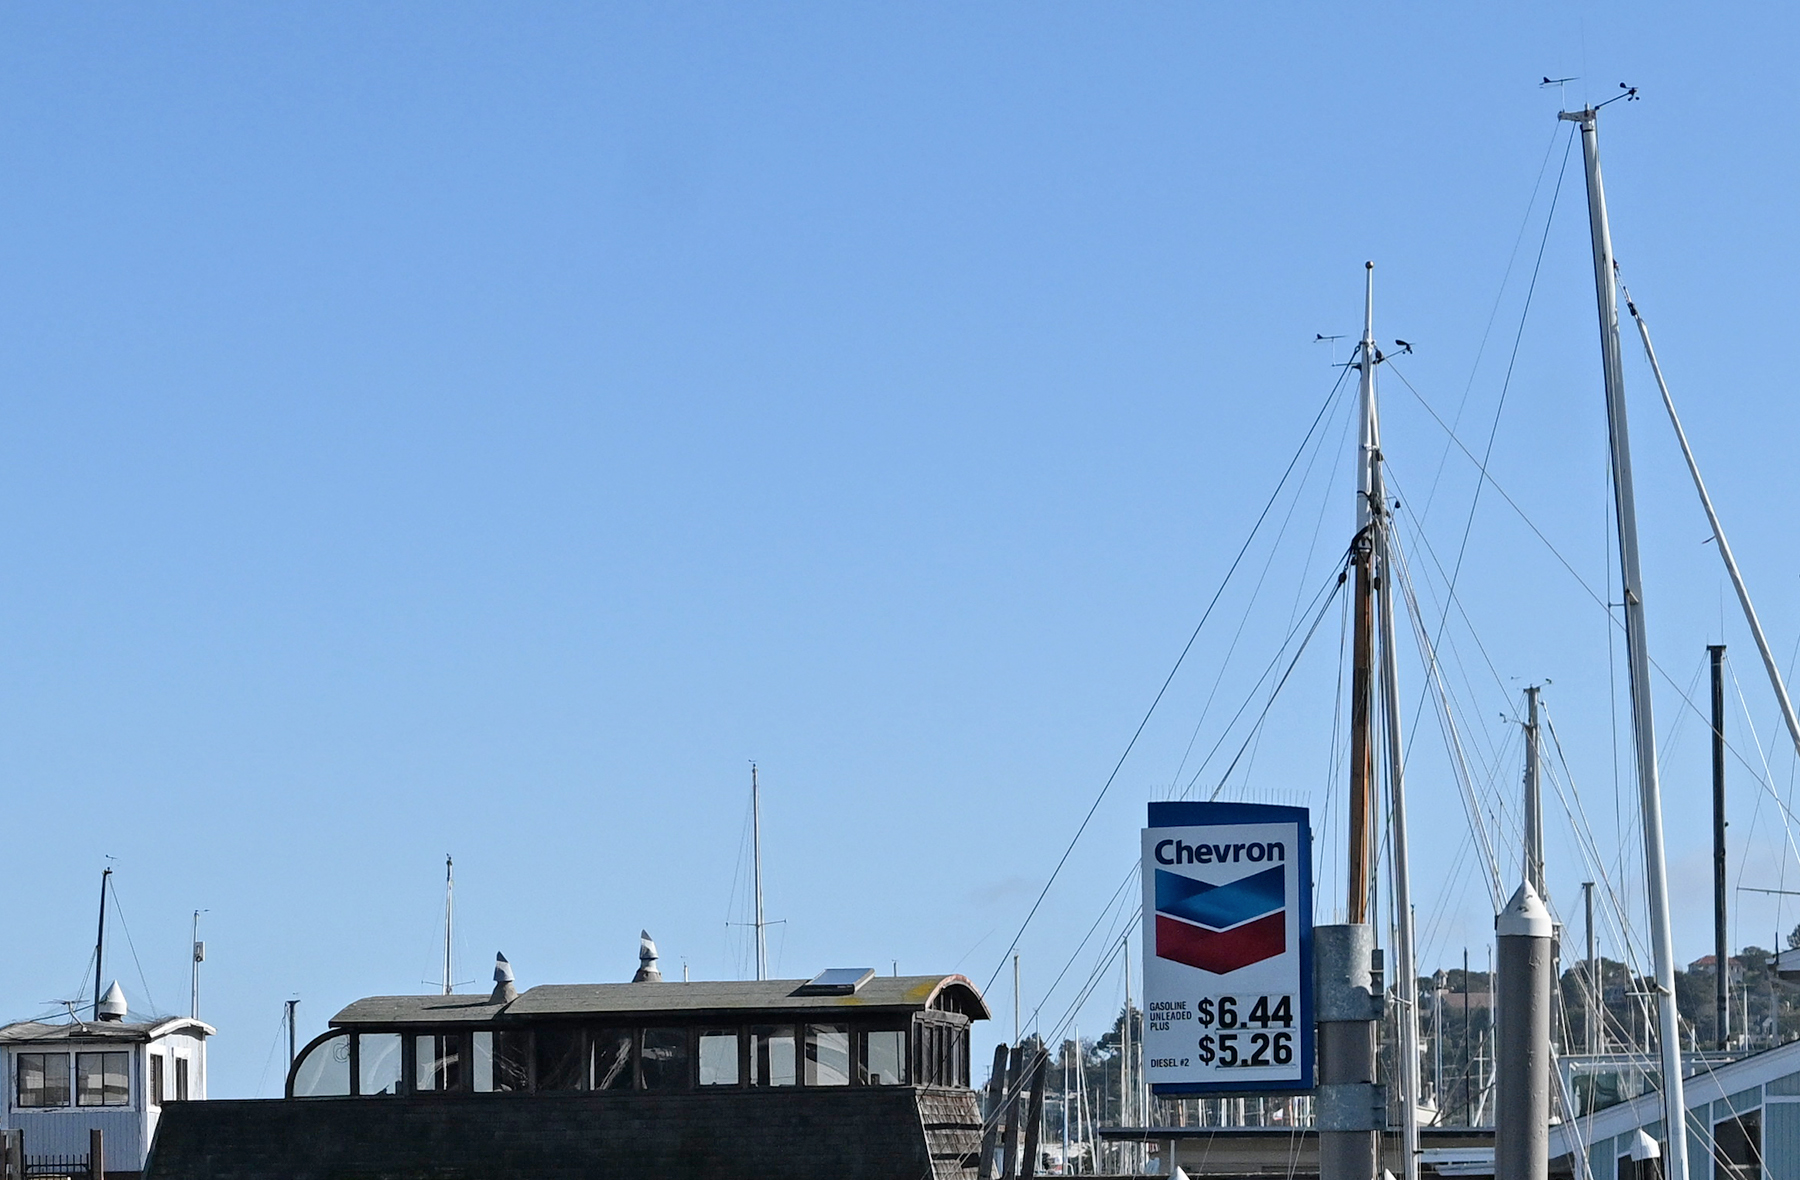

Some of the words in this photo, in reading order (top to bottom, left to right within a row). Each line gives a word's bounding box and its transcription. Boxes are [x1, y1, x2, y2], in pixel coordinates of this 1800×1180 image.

[1154, 838, 1285, 865] Chevron
[1150, 1001, 1187, 1011] GASOLINE
[1150, 1011, 1192, 1021] UNLEADED
[1198, 996, 1293, 1029] $6.44
[1150, 1022, 1170, 1031] PLUS
[1198, 1032, 1292, 1066] $5.26
[1150, 1059, 1178, 1068] DIESEL
[1180, 1058, 1189, 1067] #2
